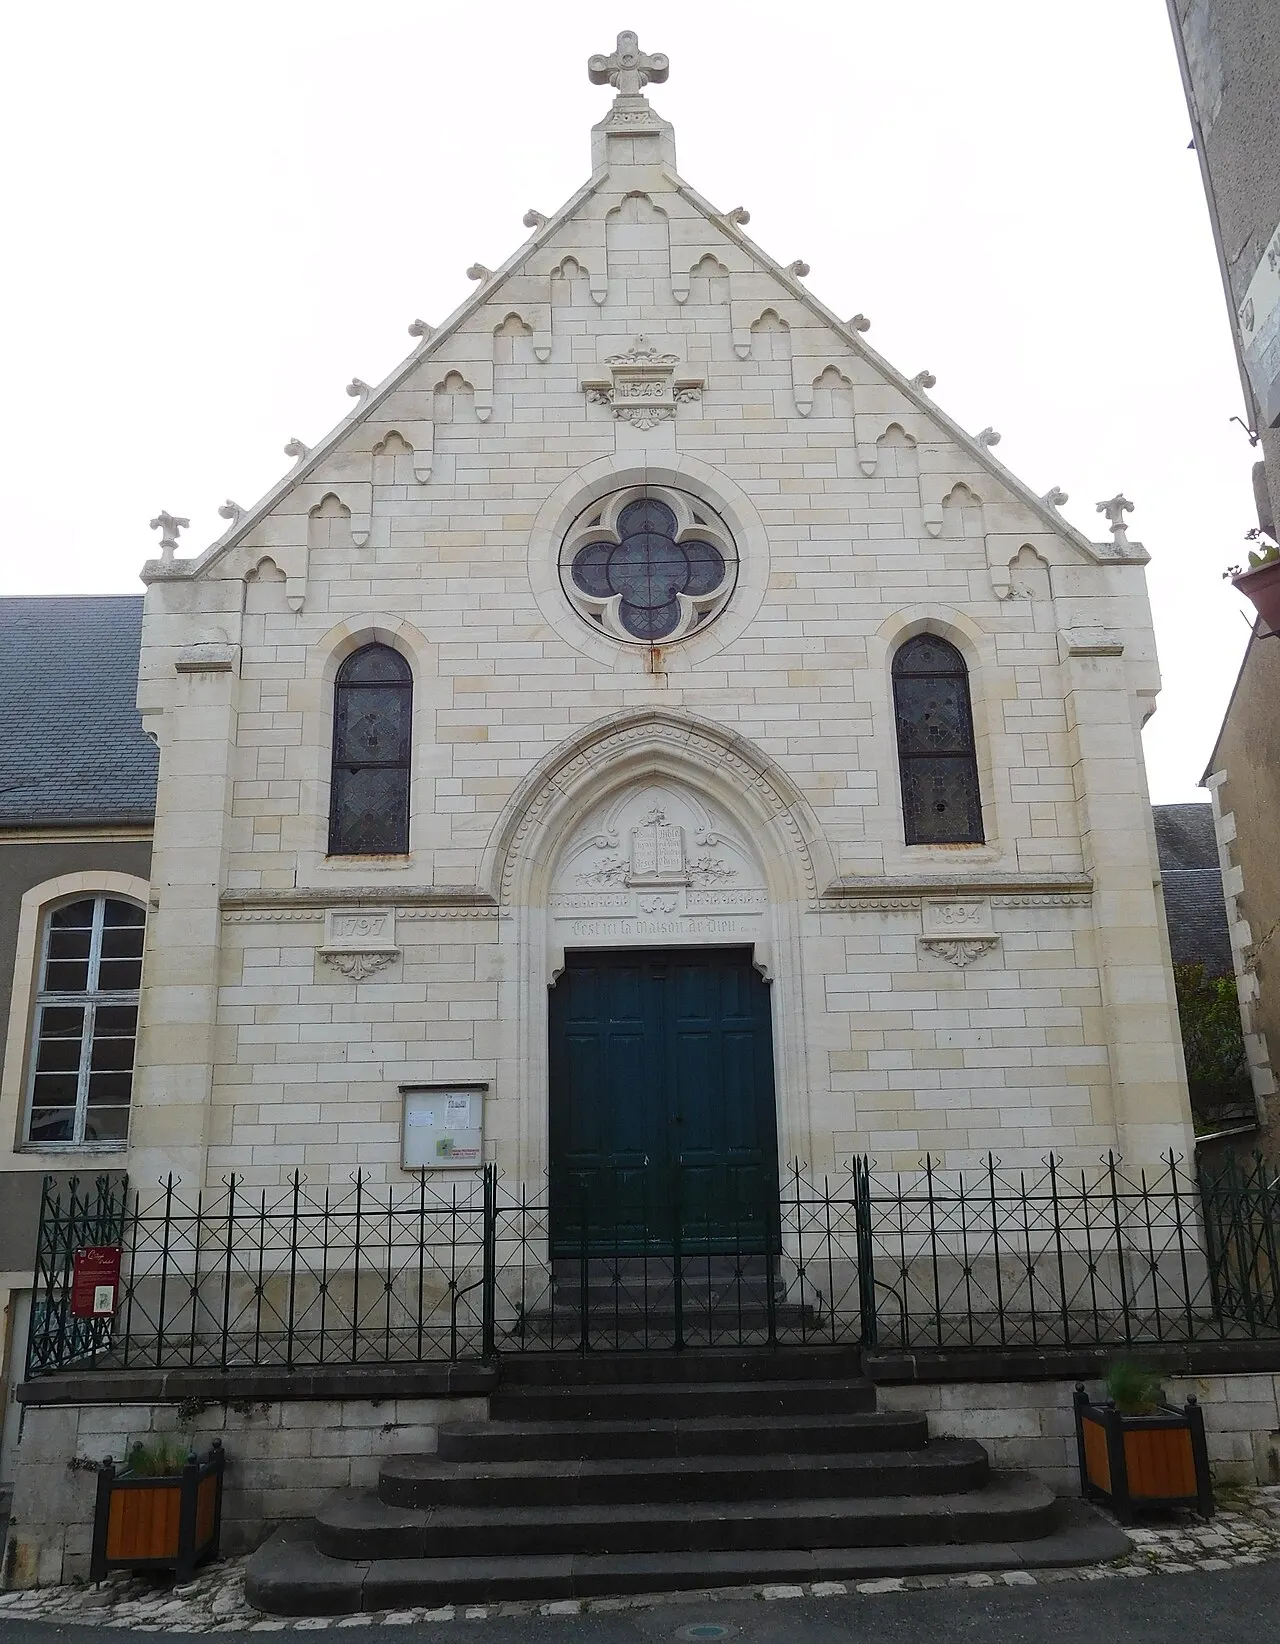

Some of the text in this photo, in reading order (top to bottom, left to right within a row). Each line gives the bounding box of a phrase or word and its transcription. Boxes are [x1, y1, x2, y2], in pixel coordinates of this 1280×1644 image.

[621, 382, 664, 398] 1548
[934, 904, 982, 924] 1894
[336, 917, 386, 937] 1797
[620, 919, 632, 935] la
[688, 917, 703, 933] de
[706, 917, 736, 932] Dieu
